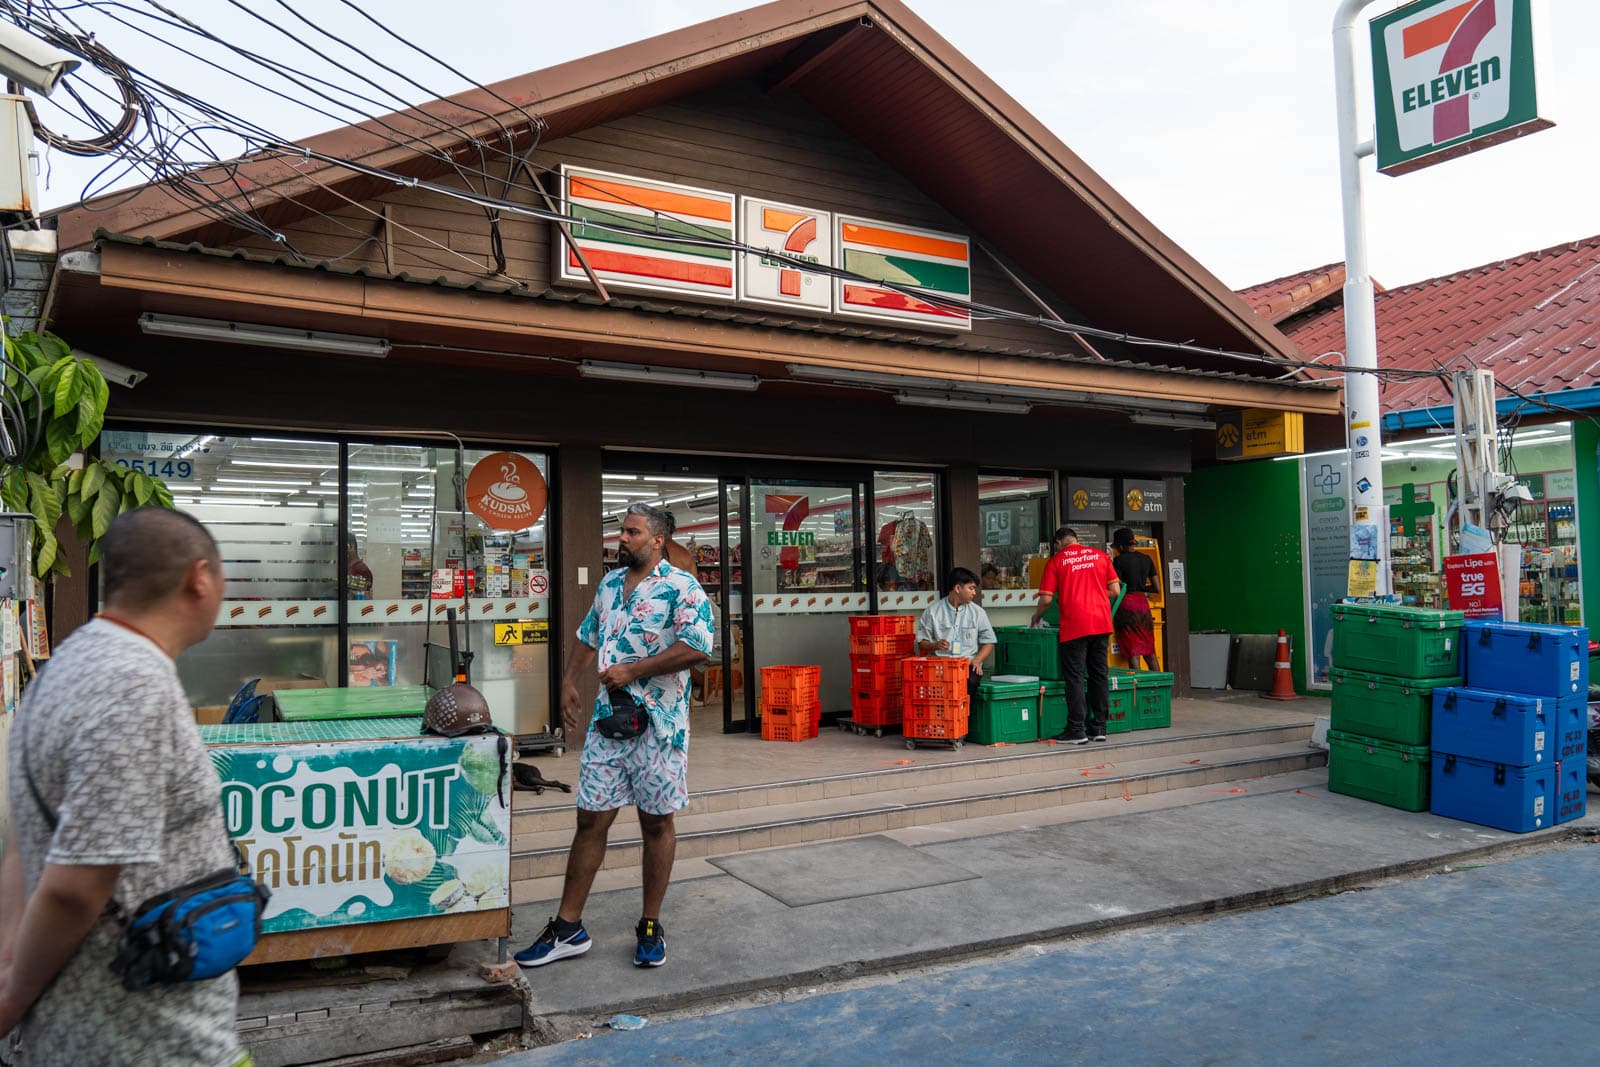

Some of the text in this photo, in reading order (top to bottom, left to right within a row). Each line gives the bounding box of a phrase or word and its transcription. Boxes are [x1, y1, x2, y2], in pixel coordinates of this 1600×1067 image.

[480, 494, 531, 513] KUDSAN
[1143, 502, 1163, 512] atm
[1062, 553, 1099, 566] important
[1464, 559, 1483, 569] Lipe
[1072, 562, 1094, 572] person
[1461, 572, 1485, 582] true
[1461, 582, 1485, 597] 5G
[221, 768, 456, 838] OCONUT
